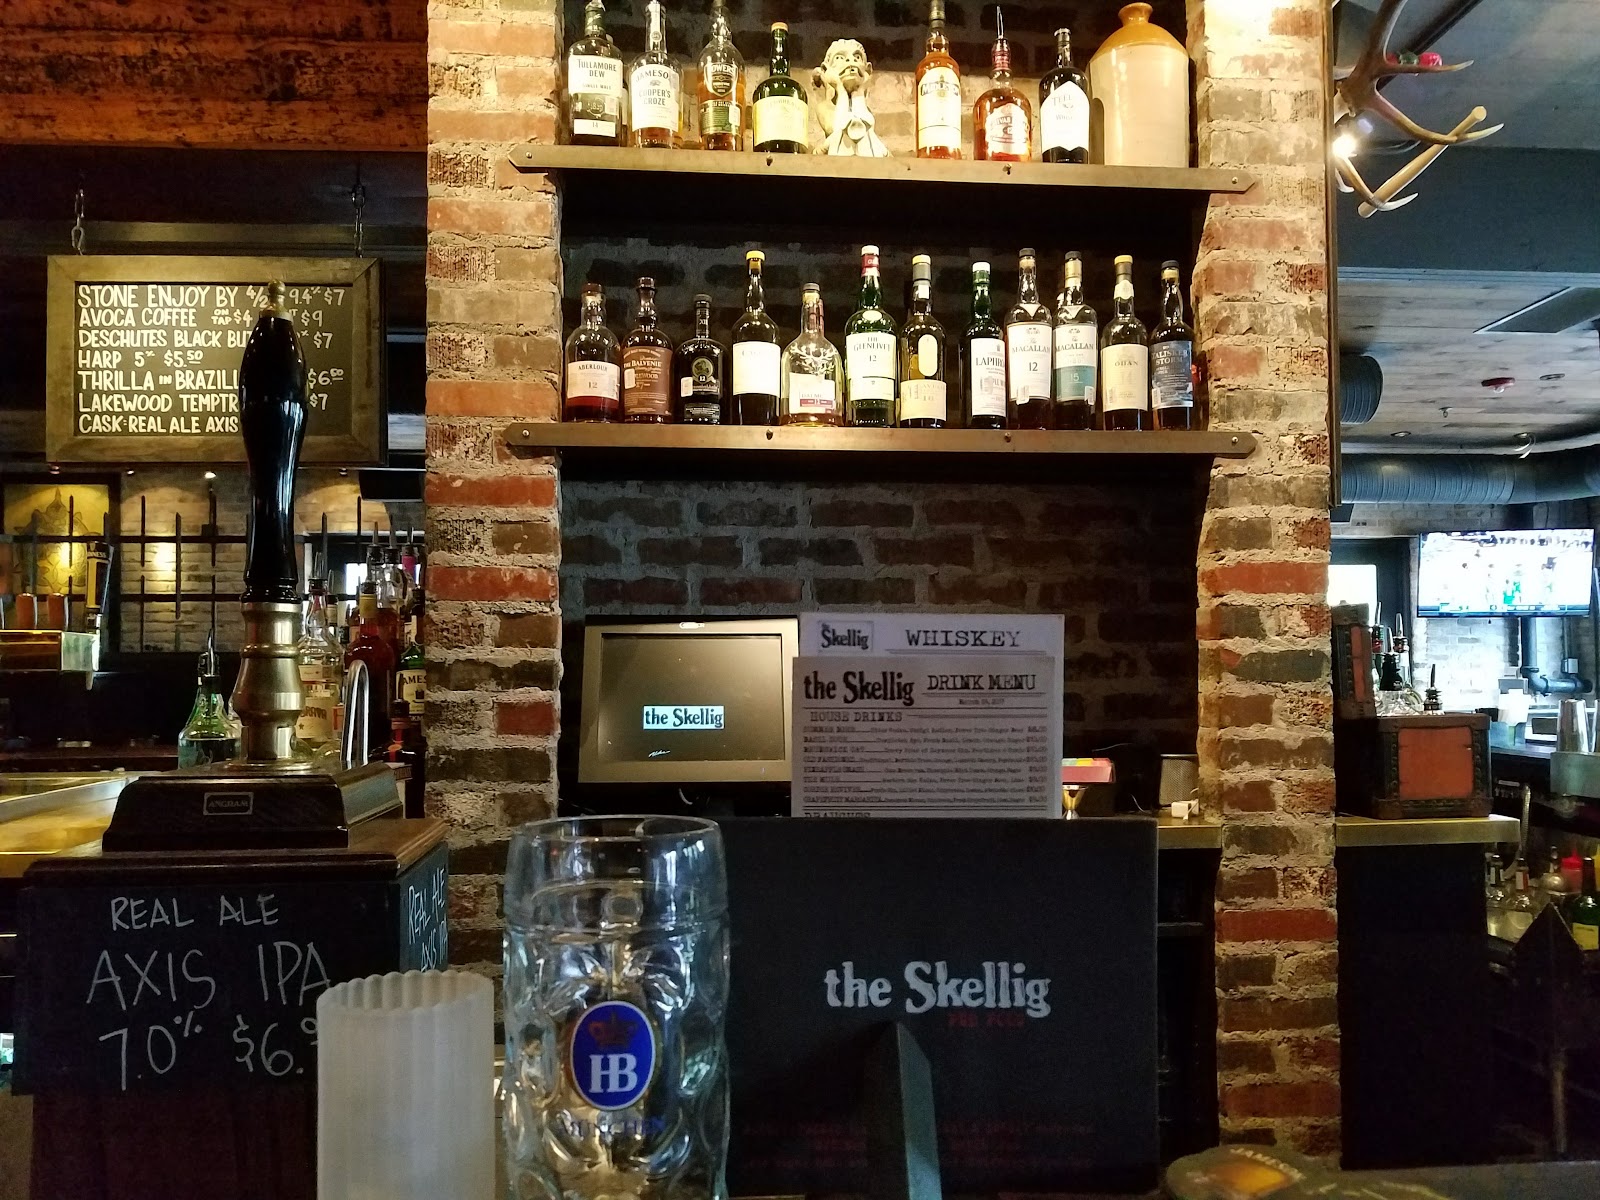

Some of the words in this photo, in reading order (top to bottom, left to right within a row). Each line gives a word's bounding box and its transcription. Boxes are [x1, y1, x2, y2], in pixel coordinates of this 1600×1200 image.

[577, 58, 617, 72] TULLAMORE
[589, 70, 606, 78] DEW
[636, 69, 670, 82] JAMESO
[638, 88, 671, 98] COOPER'S
[77, 285, 139, 308] STONE
[148, 284, 210, 308] ENJOY
[215, 286, 239, 308] BY
[246, 285, 269, 309] 4/2
[324, 288, 346, 306] $7
[80, 308, 136, 328] AVOCA
[141, 308, 198, 327] COFFEE
[211, 316, 232, 326] TAP
[234, 308, 253, 328] $4
[300, 309, 324, 327] $9
[78, 330, 168, 348] DESCHUTES
[174, 330, 222, 348] BLACK
[227, 330, 252, 348] BUT
[313, 331, 334, 349] $7
[854, 342, 890, 352] GLENLIVET
[1012, 344, 1051, 353] MACALLAN
[1055, 342, 1094, 352] MACALLAN
[78, 350, 122, 369] HARP
[134, 350, 156, 368] 5%
[869, 354, 877, 362] 12
[976, 357, 1004, 366] LAPHRO
[1152, 350, 1189, 360] TALISKER
[1155, 356, 1183, 366] STORM
[578, 364, 608, 372] ABERLOUR
[632, 360, 662, 368] BALVENIE
[1028, 362, 1038, 372] 12
[77, 370, 154, 391] THRILLA
[159, 375, 172, 385] IN
[176, 370, 238, 391] BRAZILL
[1070, 373, 1080, 382] 15
[588, 381, 598, 389] 12
[78, 393, 172, 413] LAKEWOOD
[178, 394, 239, 413] TEMPTR
[309, 392, 329, 411] $7
[128, 416, 167, 433] REAL
[169, 416, 201, 434] ALE
[205, 416, 239, 433] AXIS
[821, 628, 869, 650] Skellig
[906, 630, 1021, 648] WHISKEY
[402, 674, 427, 685] AMES
[804, 670, 837, 700] the
[843, 670, 915, 706] Skellig
[927, 674, 984, 690] DRINK
[988, 674, 1036, 690] MENU
[644, 708, 668, 725] the
[672, 708, 724, 728] Skellig
[810, 712, 850, 722] HOUSE
[854, 712, 903, 722] DRINKS
[208, 800, 250, 808] ANGRAM
[111, 896, 194, 931] REAL
[218, 894, 280, 926] ALE
[408, 885, 431, 944] REAL
[86, 948, 217, 1011] AXIS
[258, 941, 331, 1006] IPA
[824, 961, 892, 1008] the
[904, 960, 1051, 1018] Skellig
[99, 1011, 203, 1092] 7.0%
[588, 1053, 638, 1094] HB
